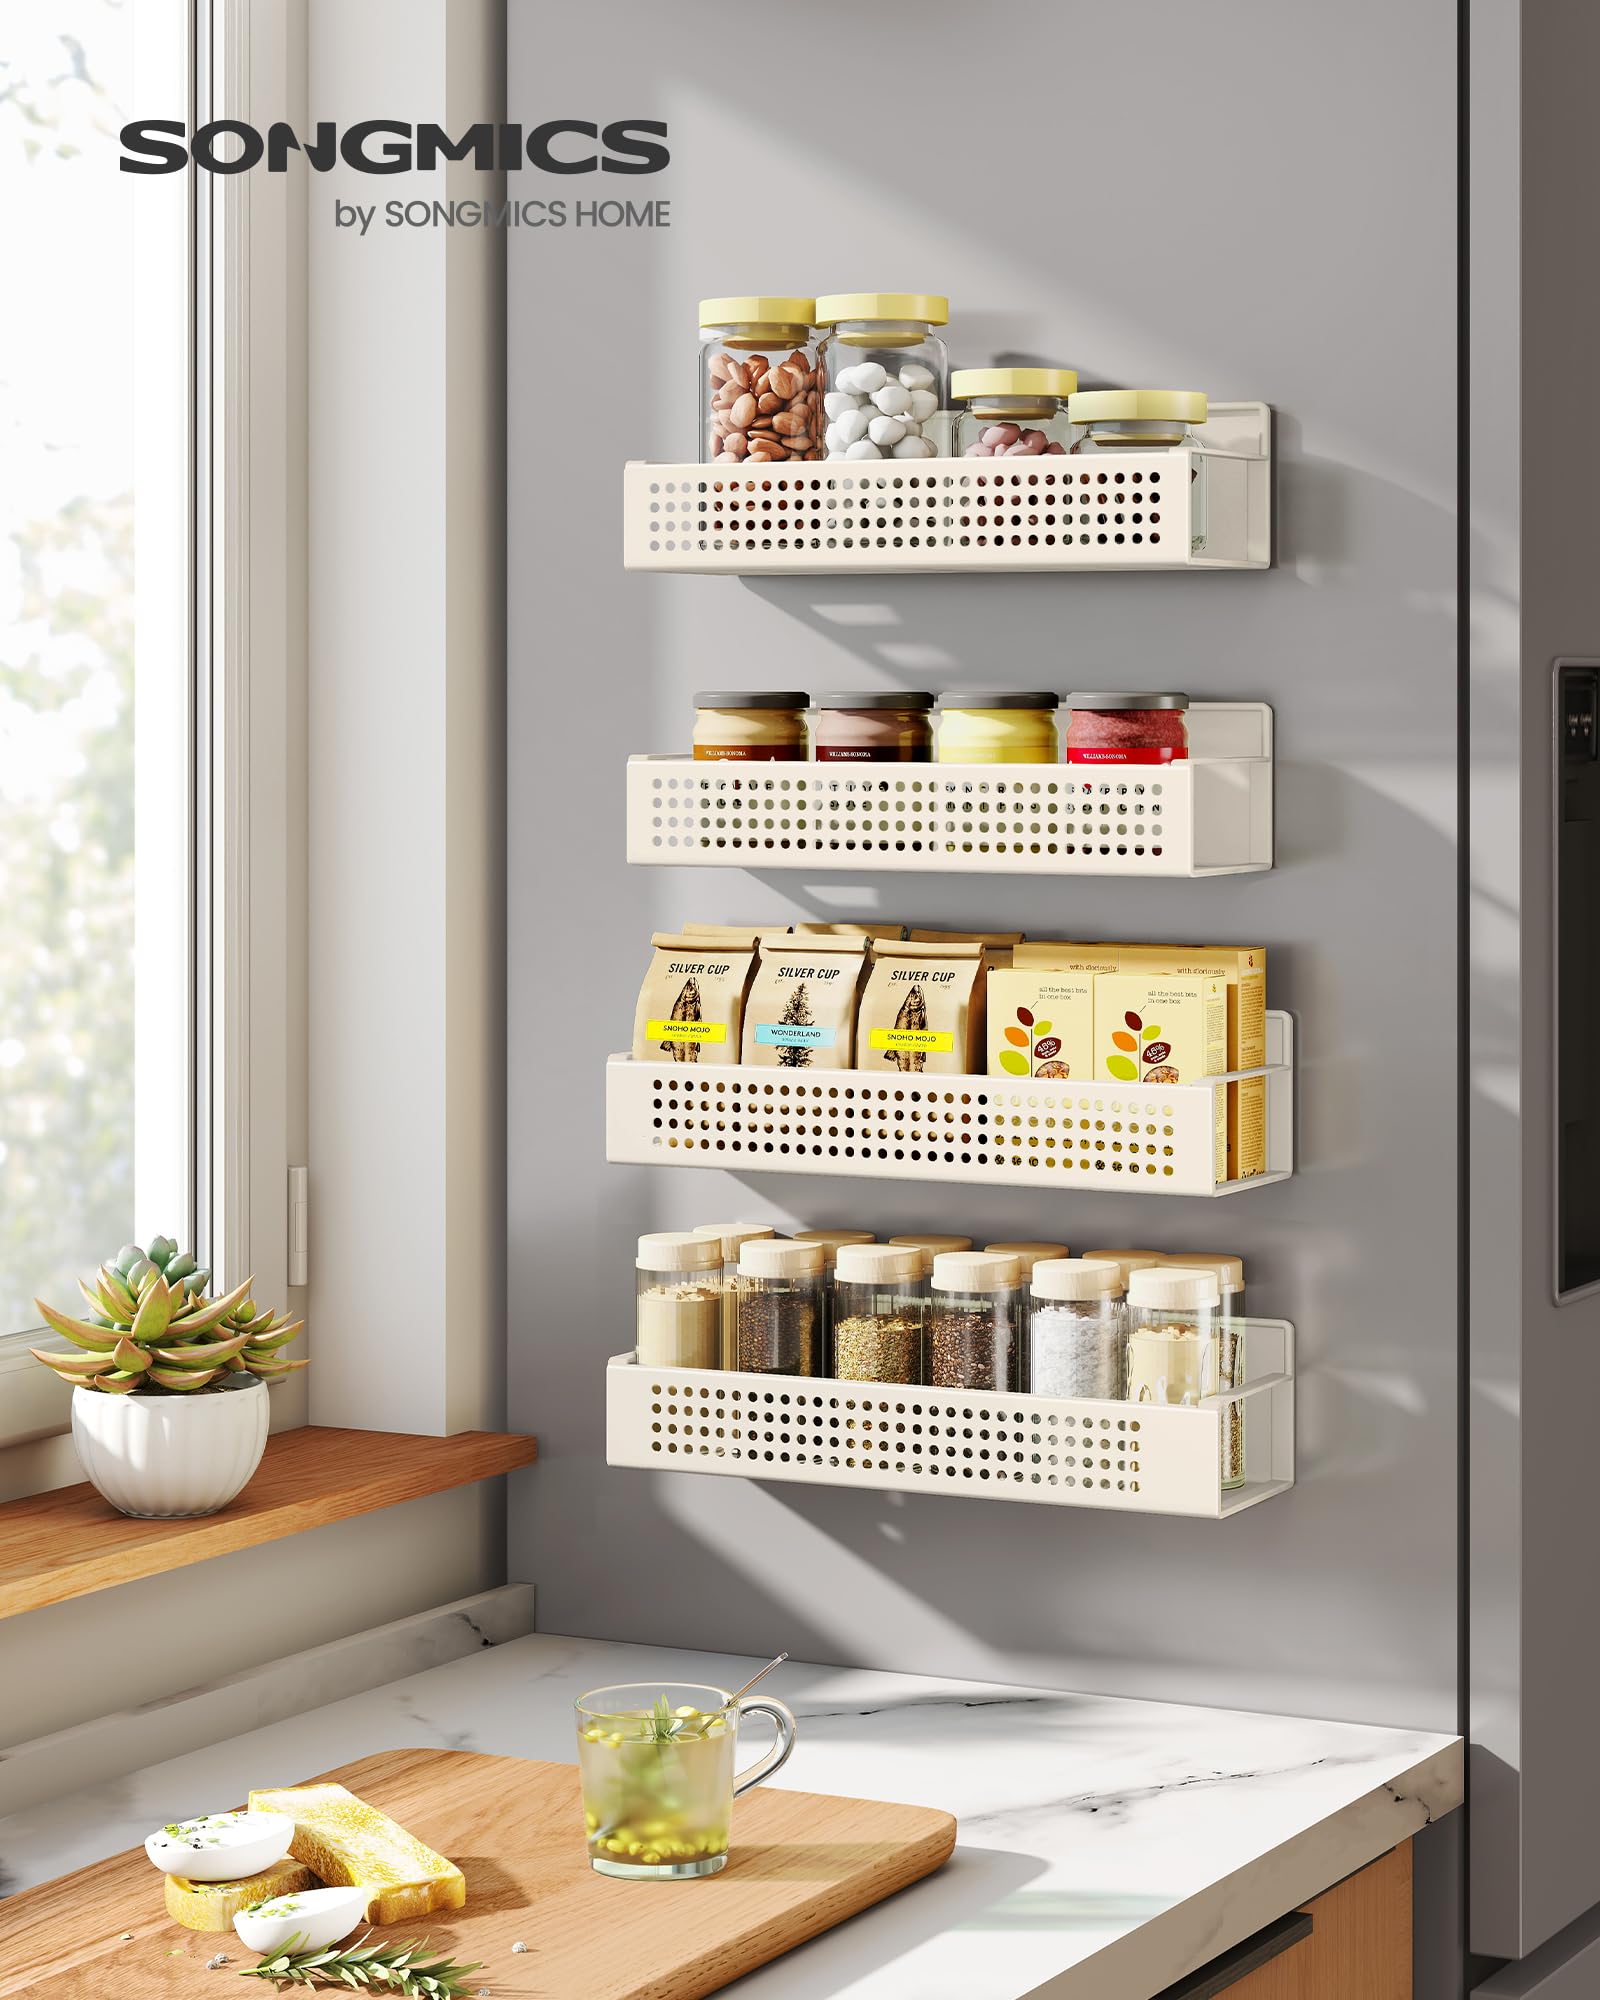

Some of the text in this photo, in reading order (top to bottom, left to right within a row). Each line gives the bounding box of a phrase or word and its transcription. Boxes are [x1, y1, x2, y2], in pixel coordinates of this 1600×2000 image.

[668, 963, 730, 975] SILVER CUP
[778, 967, 840, 979] SILVER CUP
[891, 970, 956, 982] SILVER CUP
[771, 1029, 821, 1038] WONDERLAND
[887, 1033, 914, 1041] SNOHO
